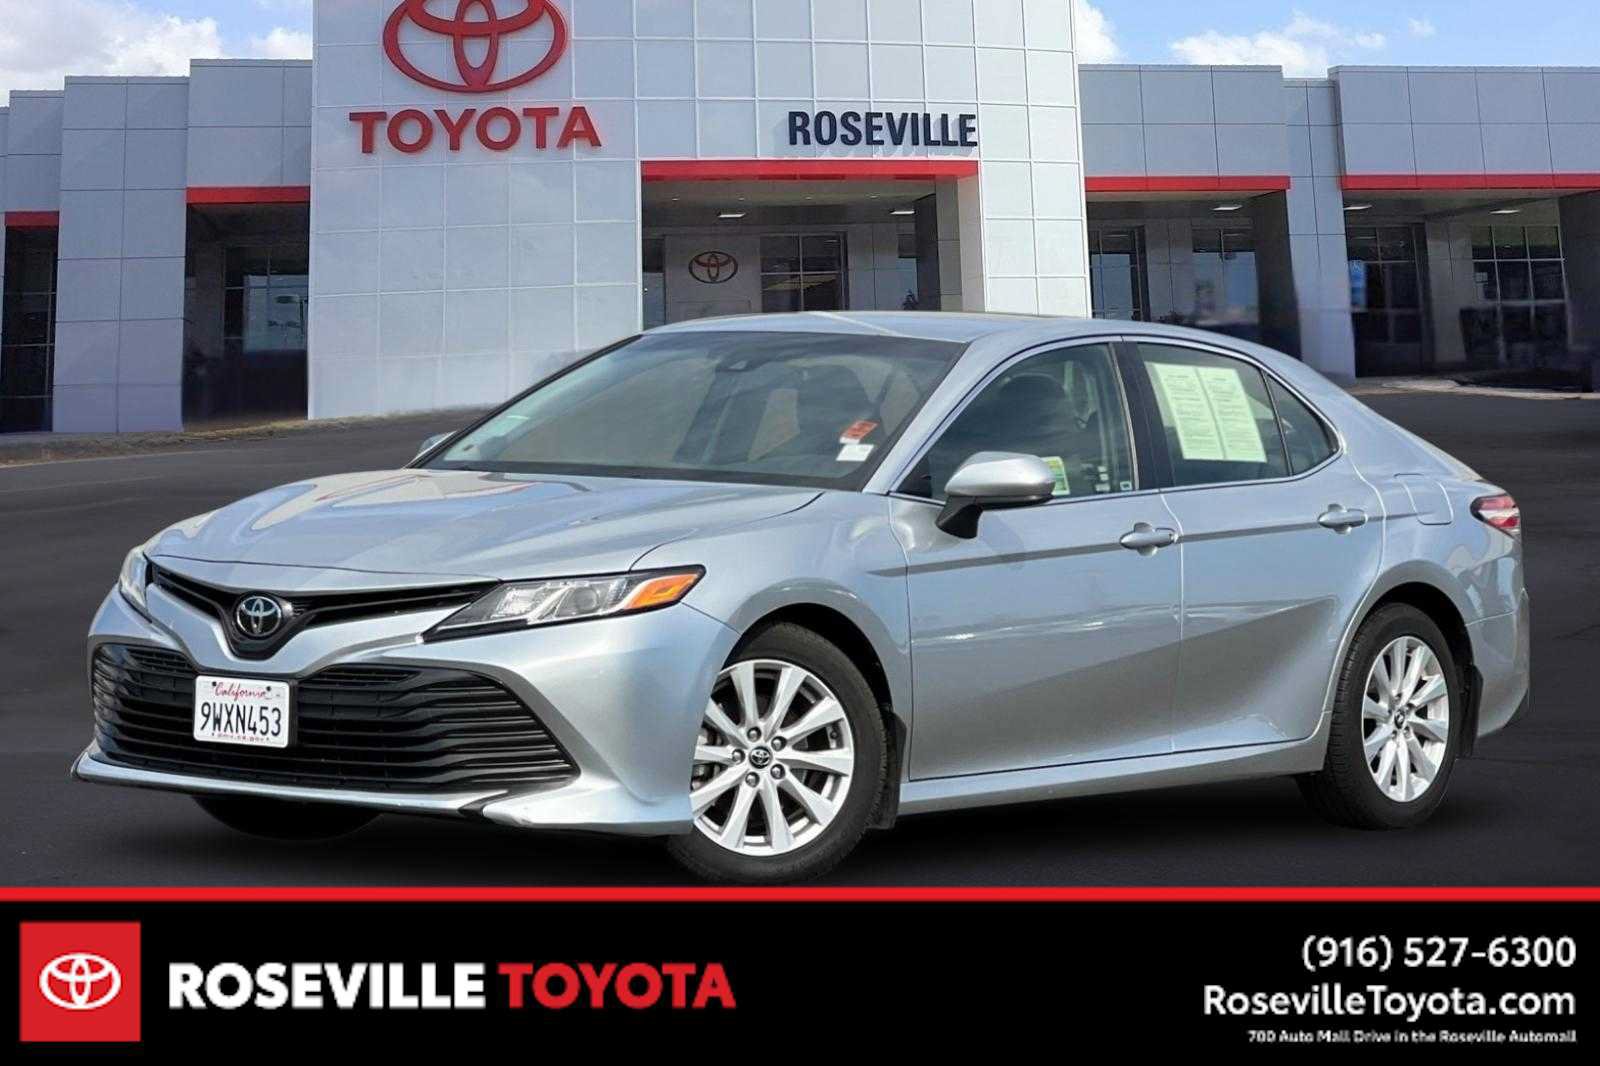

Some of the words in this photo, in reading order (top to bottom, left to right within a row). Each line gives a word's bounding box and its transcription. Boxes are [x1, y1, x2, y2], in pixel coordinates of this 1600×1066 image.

[349, 106, 602, 154] TOYOTA
[788, 110, 978, 147] ROSEVILLE
[215, 681, 267, 701] California
[200, 701, 281, 736] 9WXN453
